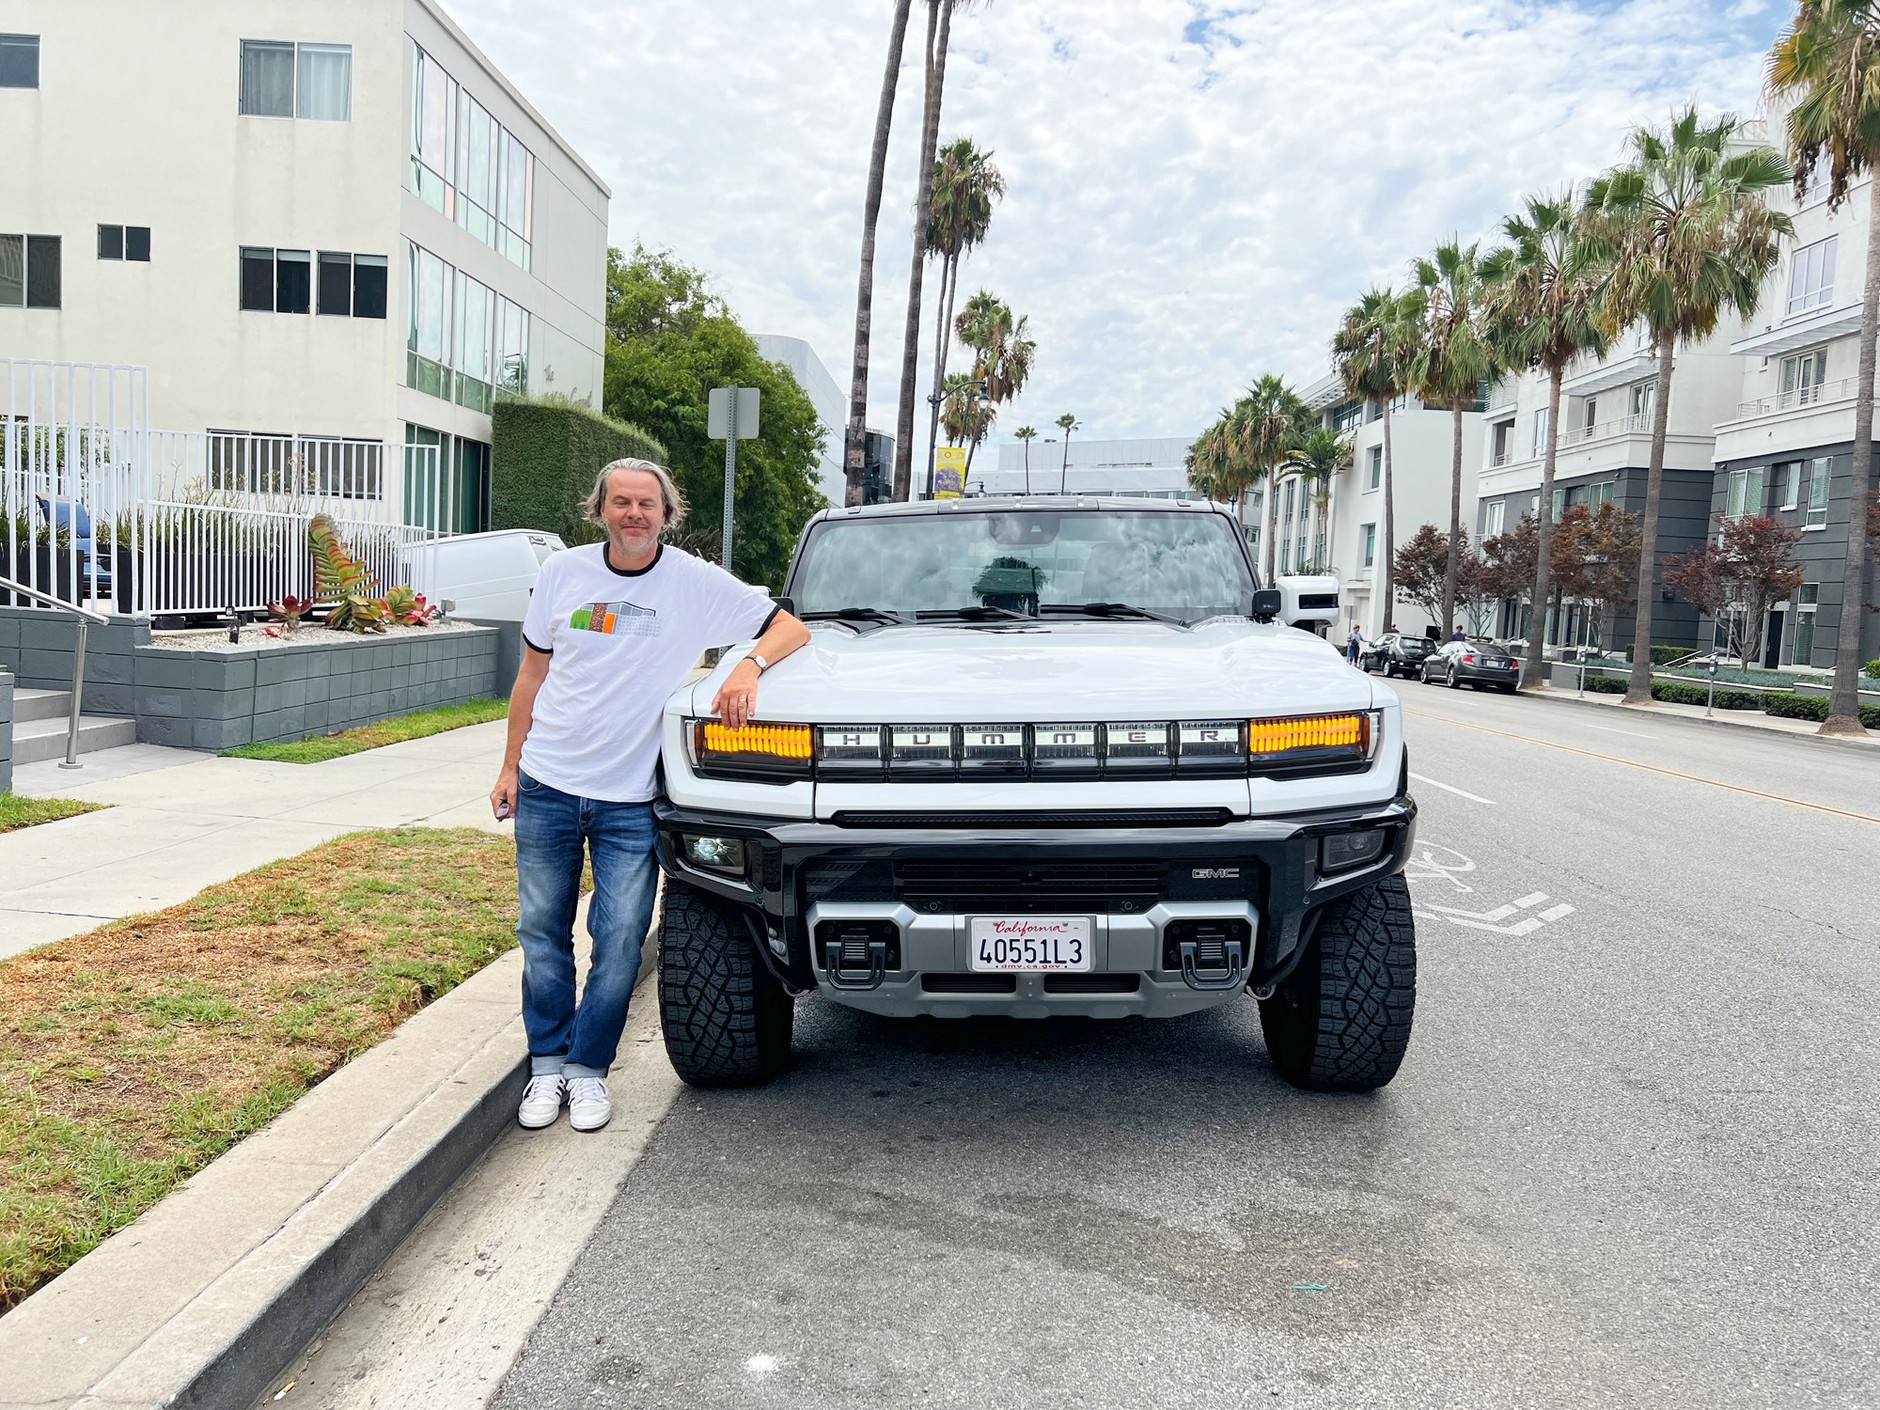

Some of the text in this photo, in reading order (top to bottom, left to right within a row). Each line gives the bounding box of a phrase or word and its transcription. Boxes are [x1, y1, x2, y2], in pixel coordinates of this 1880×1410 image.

[843, 731, 1219, 745] HUMMER
[1191, 868, 1240, 879] GMC
[995, 920, 1068, 937] California
[979, 938, 1083, 964] 40551L3
